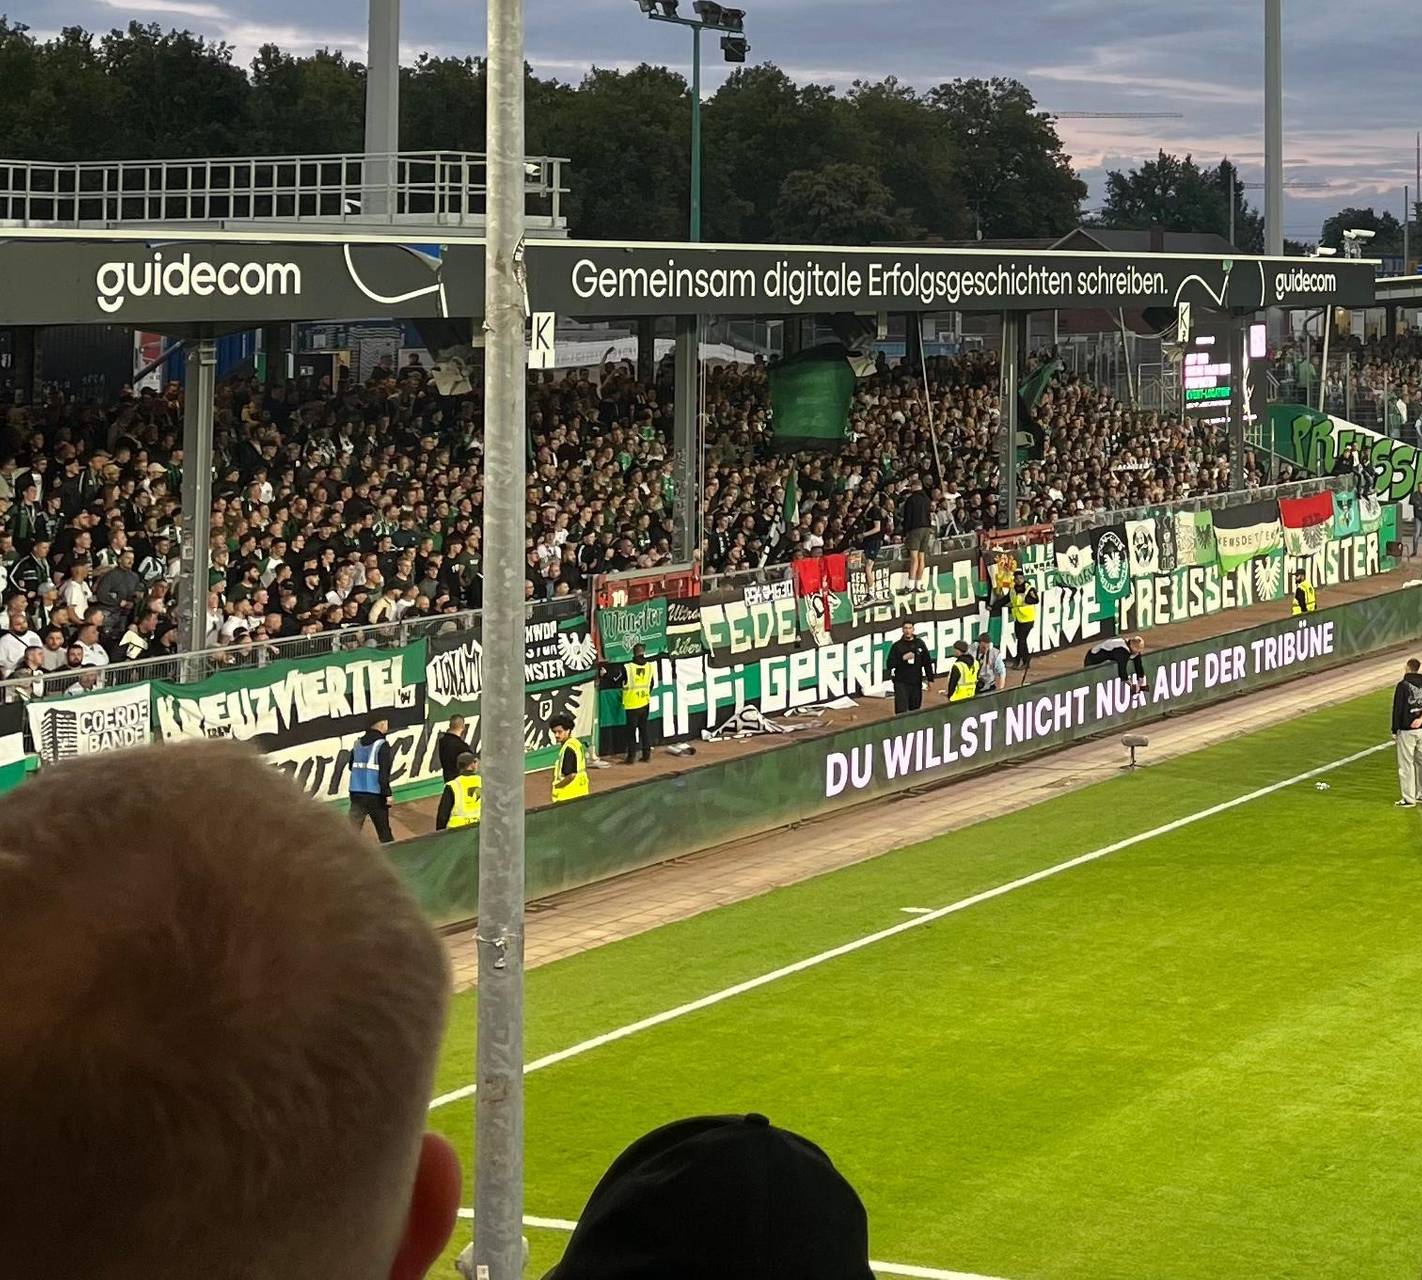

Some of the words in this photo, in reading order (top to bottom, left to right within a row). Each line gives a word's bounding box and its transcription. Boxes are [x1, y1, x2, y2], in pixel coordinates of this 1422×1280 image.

[96, 253, 300, 312] guidecom
[572, 259, 755, 298] Gemeinsam
[764, 260, 862, 305] digitale
[869, 262, 1072, 303] Erfolgsgeschichten
[1078, 265, 1169, 295] schreiben.
[1276, 269, 1336, 300] guidecom
[537, 316, 550, 350] K
[1180, 305, 1189, 330] K
[1118, 559, 1253, 630] PREUSSEN
[525, 659, 566, 682] NSTER
[157, 655, 403, 744] KREUZVIERTEL
[826, 744, 873, 798] DU
[883, 710, 998, 781] WILLST
[1005, 685, 1091, 747] NICHT
[1152, 656, 1200, 704] AUF
[1204, 647, 1247, 689] DER
[1251, 621, 1335, 674] TRIBÜNE
[80, 701, 148, 735] COERDE
[89, 723, 146, 751] BANDE
